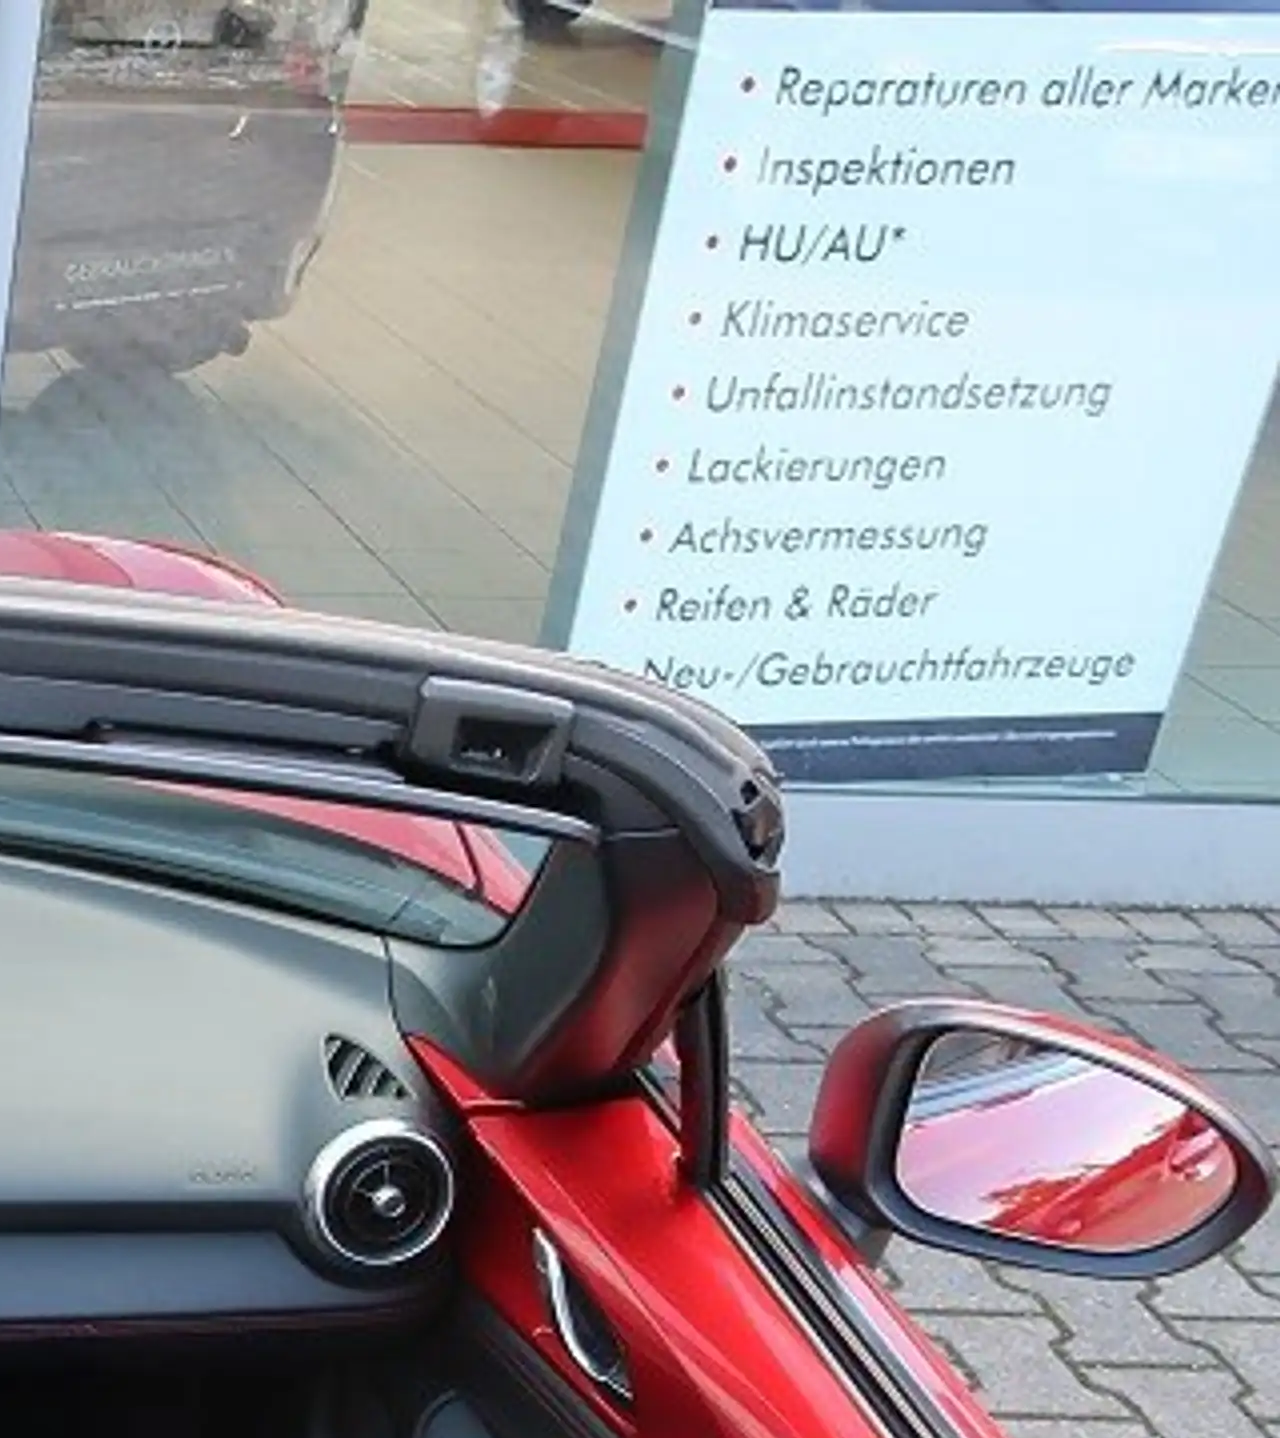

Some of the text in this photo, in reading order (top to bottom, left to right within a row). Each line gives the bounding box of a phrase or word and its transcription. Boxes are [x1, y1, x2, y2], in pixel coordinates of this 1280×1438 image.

[776, 64, 1027, 117] Reparaturen
[1041, 64, 1134, 109] aller
[757, 144, 1016, 190] Inspektionen
[720, 300, 970, 341] Klimaservice
[705, 371, 1113, 418] Unfallinstandsetzung
[687, 446, 947, 491] Lackierungen
[667, 515, 989, 558] Achsvermessung
[655, 580, 941, 624] Reifen & Räder
[643, 647, 1137, 691] Neu-/Gebrauchtfahrzeuge
